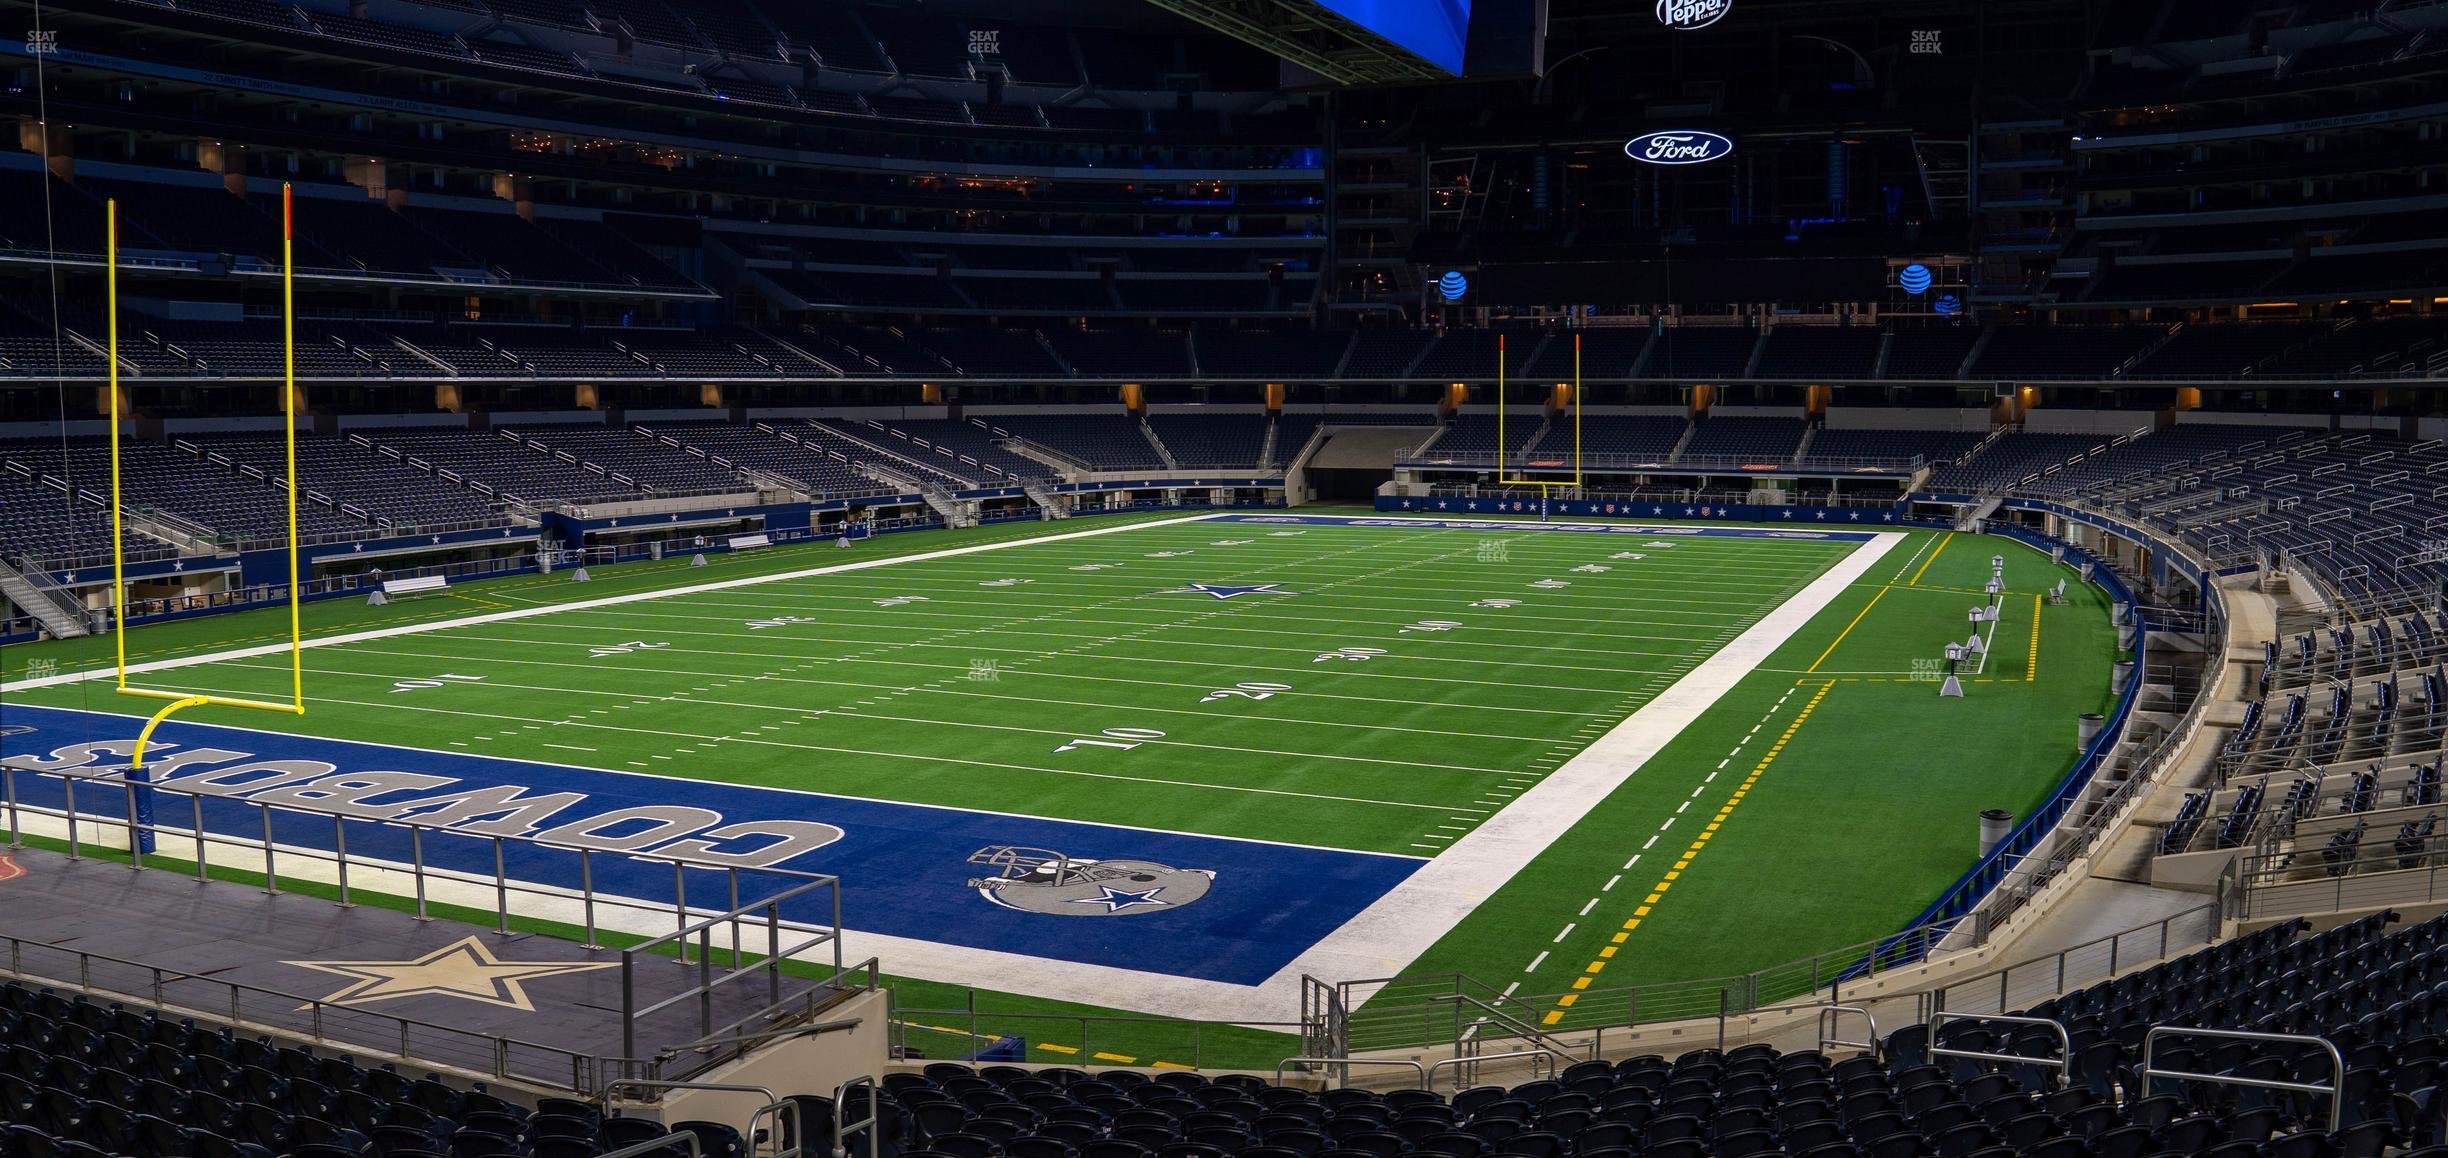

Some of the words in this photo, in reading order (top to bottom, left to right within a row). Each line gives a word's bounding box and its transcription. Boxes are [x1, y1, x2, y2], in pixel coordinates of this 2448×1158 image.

[1645, 135, 1711, 159] Ford
[1209, 682, 1292, 701] 20
[1068, 727, 1167, 751] 10
[0, 740, 845, 870] COWBOYS
